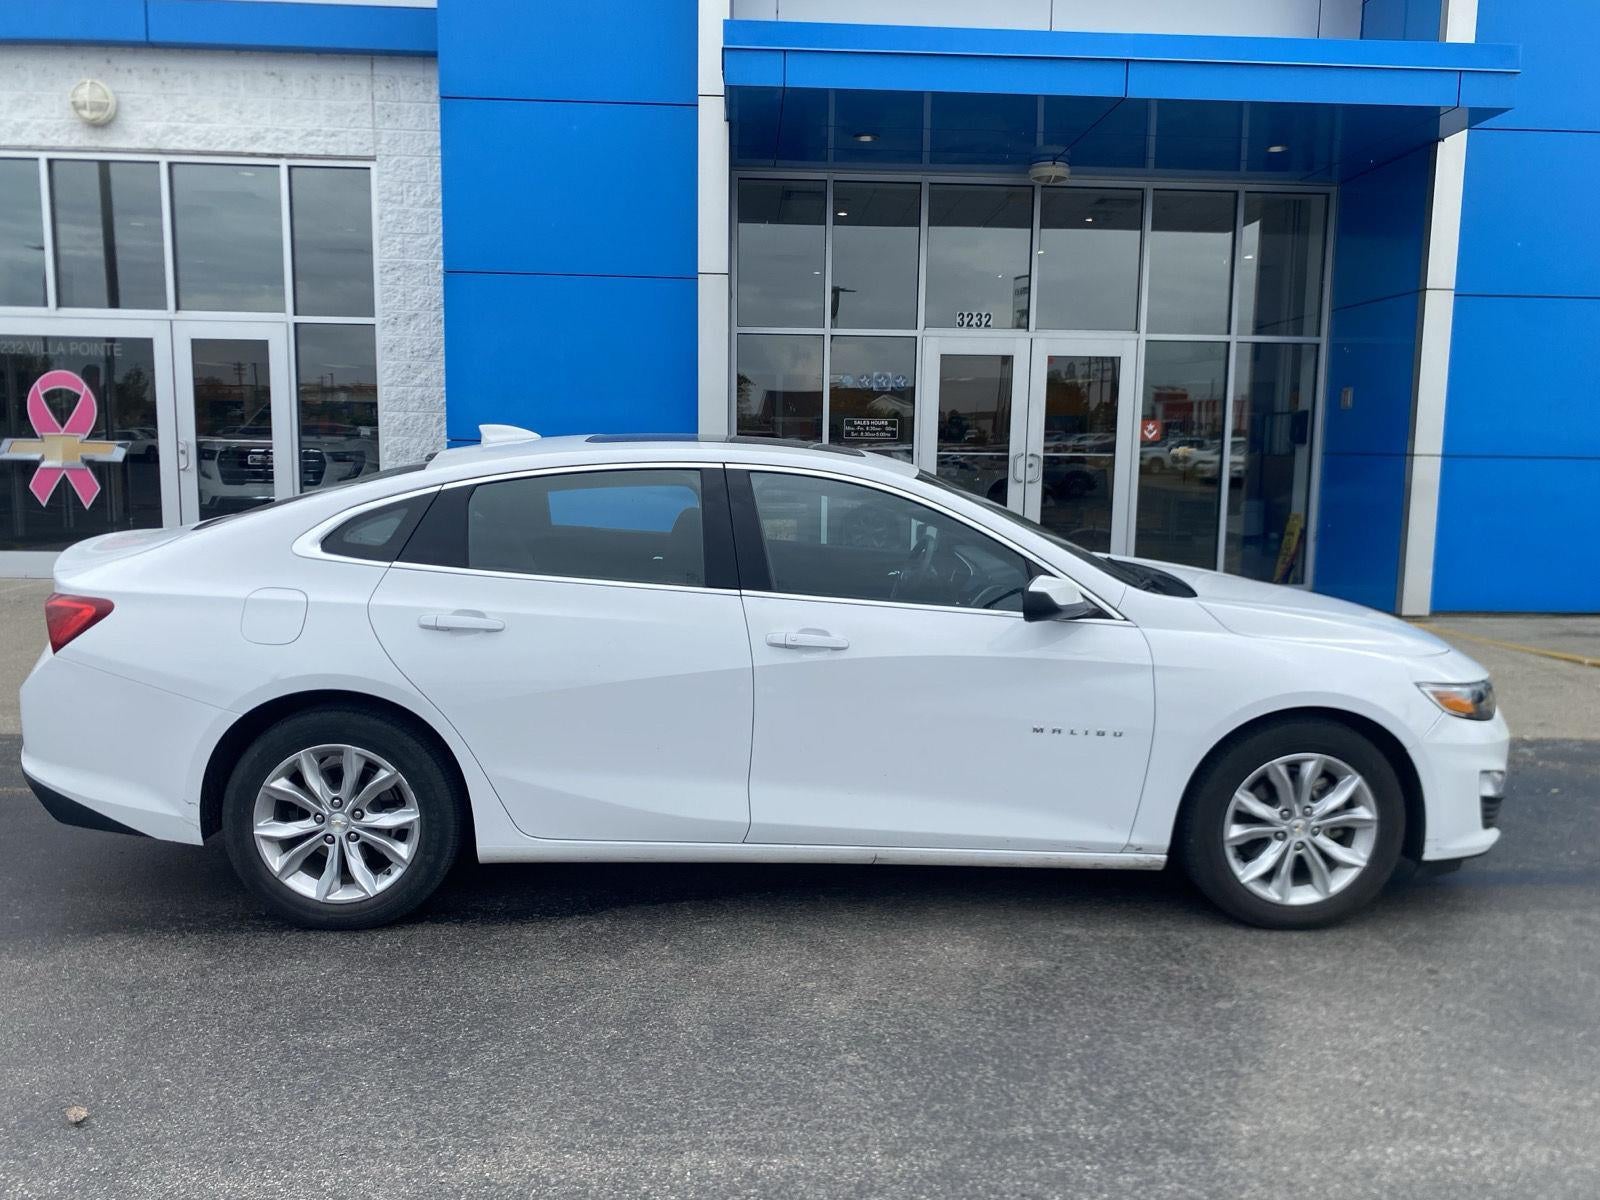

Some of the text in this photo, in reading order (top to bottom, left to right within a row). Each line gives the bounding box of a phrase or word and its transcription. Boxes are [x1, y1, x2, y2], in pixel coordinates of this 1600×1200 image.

[957, 312, 992, 328] 3232
[26, 341, 65, 355] VILLA
[70, 342, 123, 357] POINTE
[1032, 727, 1123, 738] MALIBU
